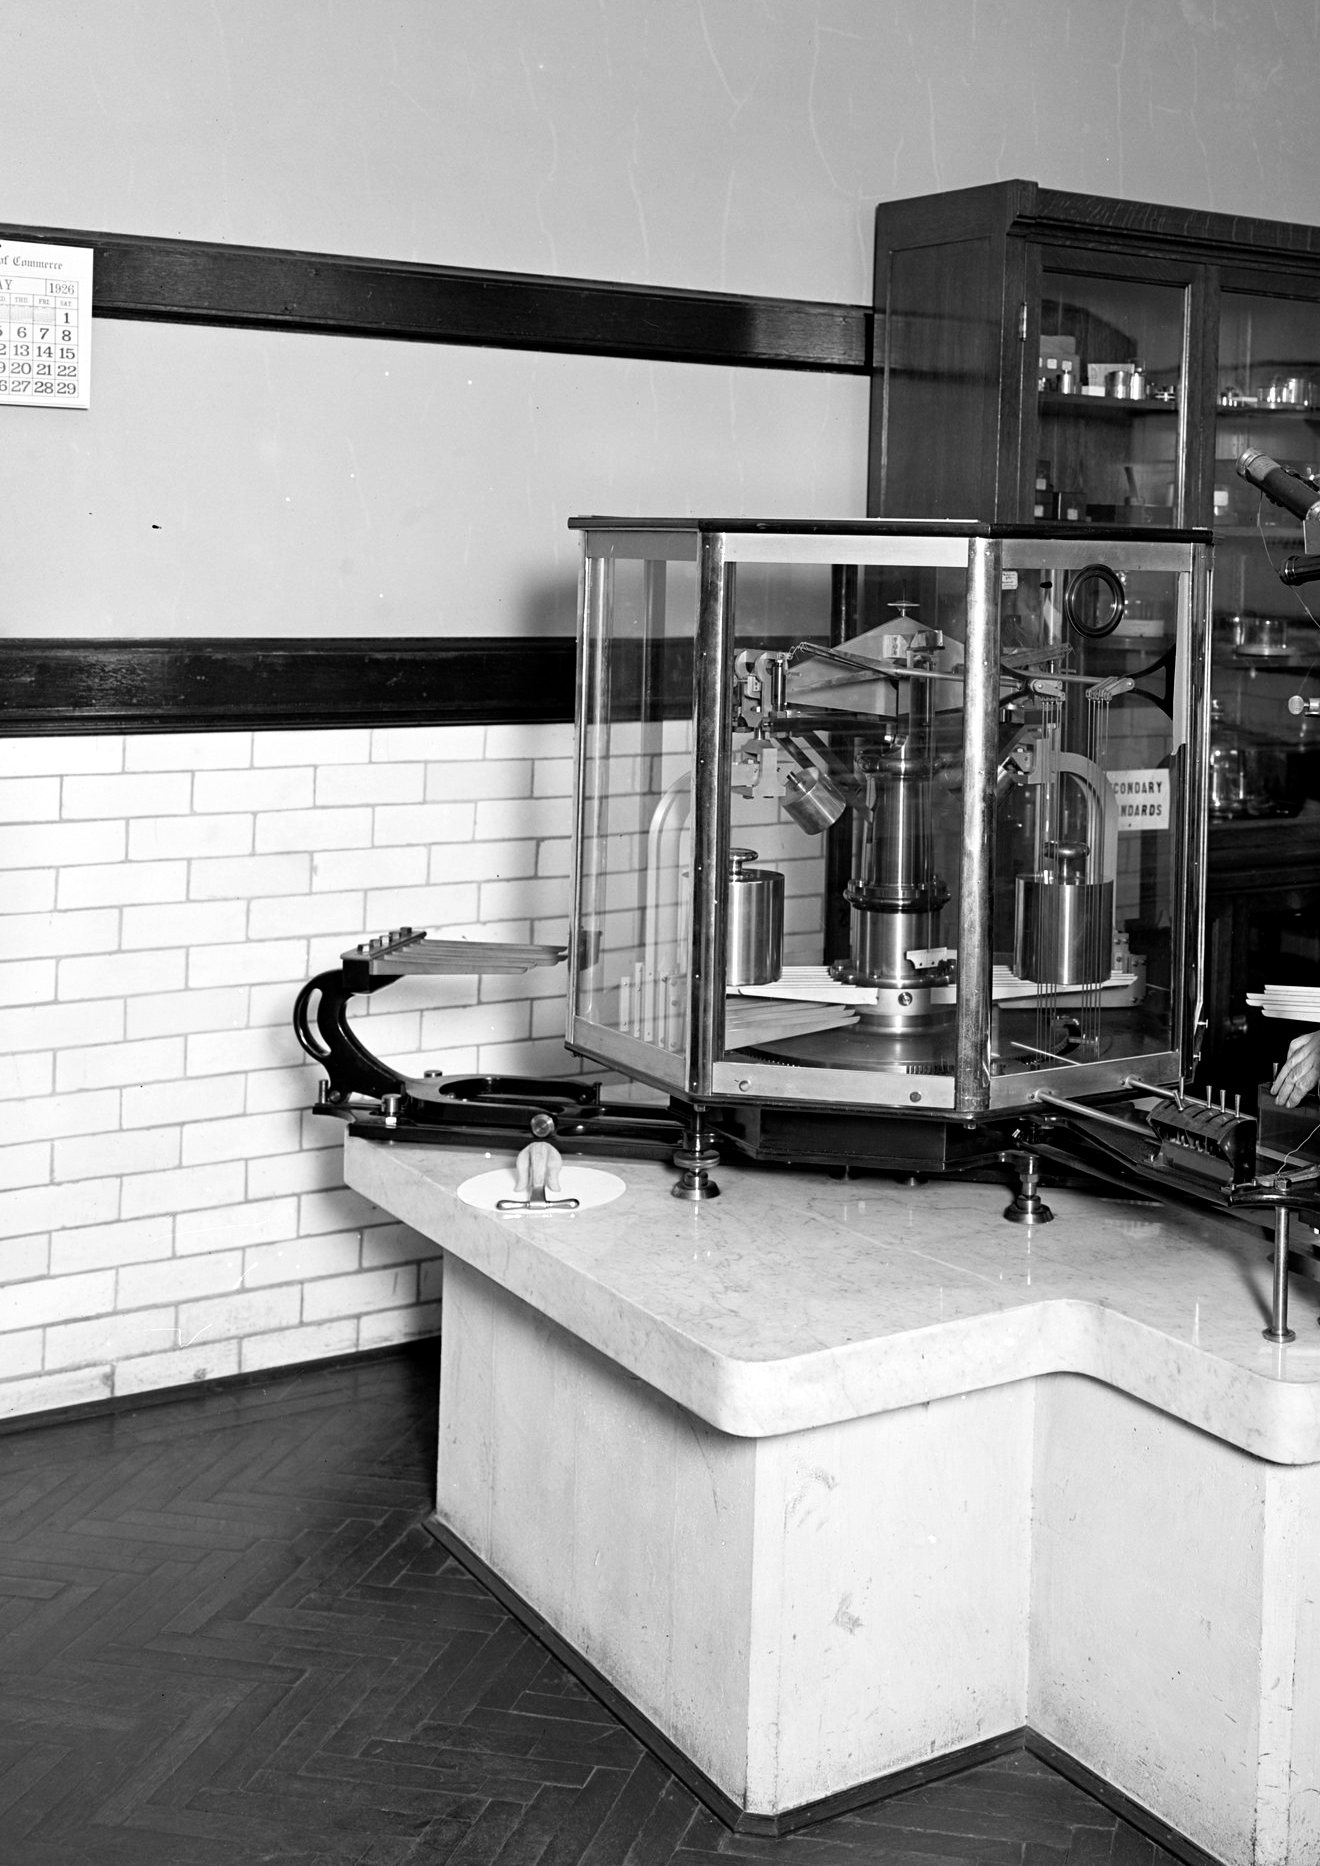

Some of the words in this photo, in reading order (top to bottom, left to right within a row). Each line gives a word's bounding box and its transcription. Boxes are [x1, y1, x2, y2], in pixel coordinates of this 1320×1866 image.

[13, 256, 63, 270] Commerce
[0, 279, 13, 290] Y
[50, 283, 75, 295] 1926
[64, 312, 70, 324] 1
[17, 326, 27, 338] 6
[39, 328, 49, 340] 7
[62, 329, 72, 342] 8
[13, 344, 30, 357] 13
[36, 346, 53, 358] 14
[59, 347, 76, 360] 15
[11, 362, 32, 375] 20
[36, 363, 52, 376] 21
[57, 365, 77, 377] 22
[11, 380, 31, 392] 27
[34, 381, 54, 394] 28
[57, 382, 76, 395] 29
